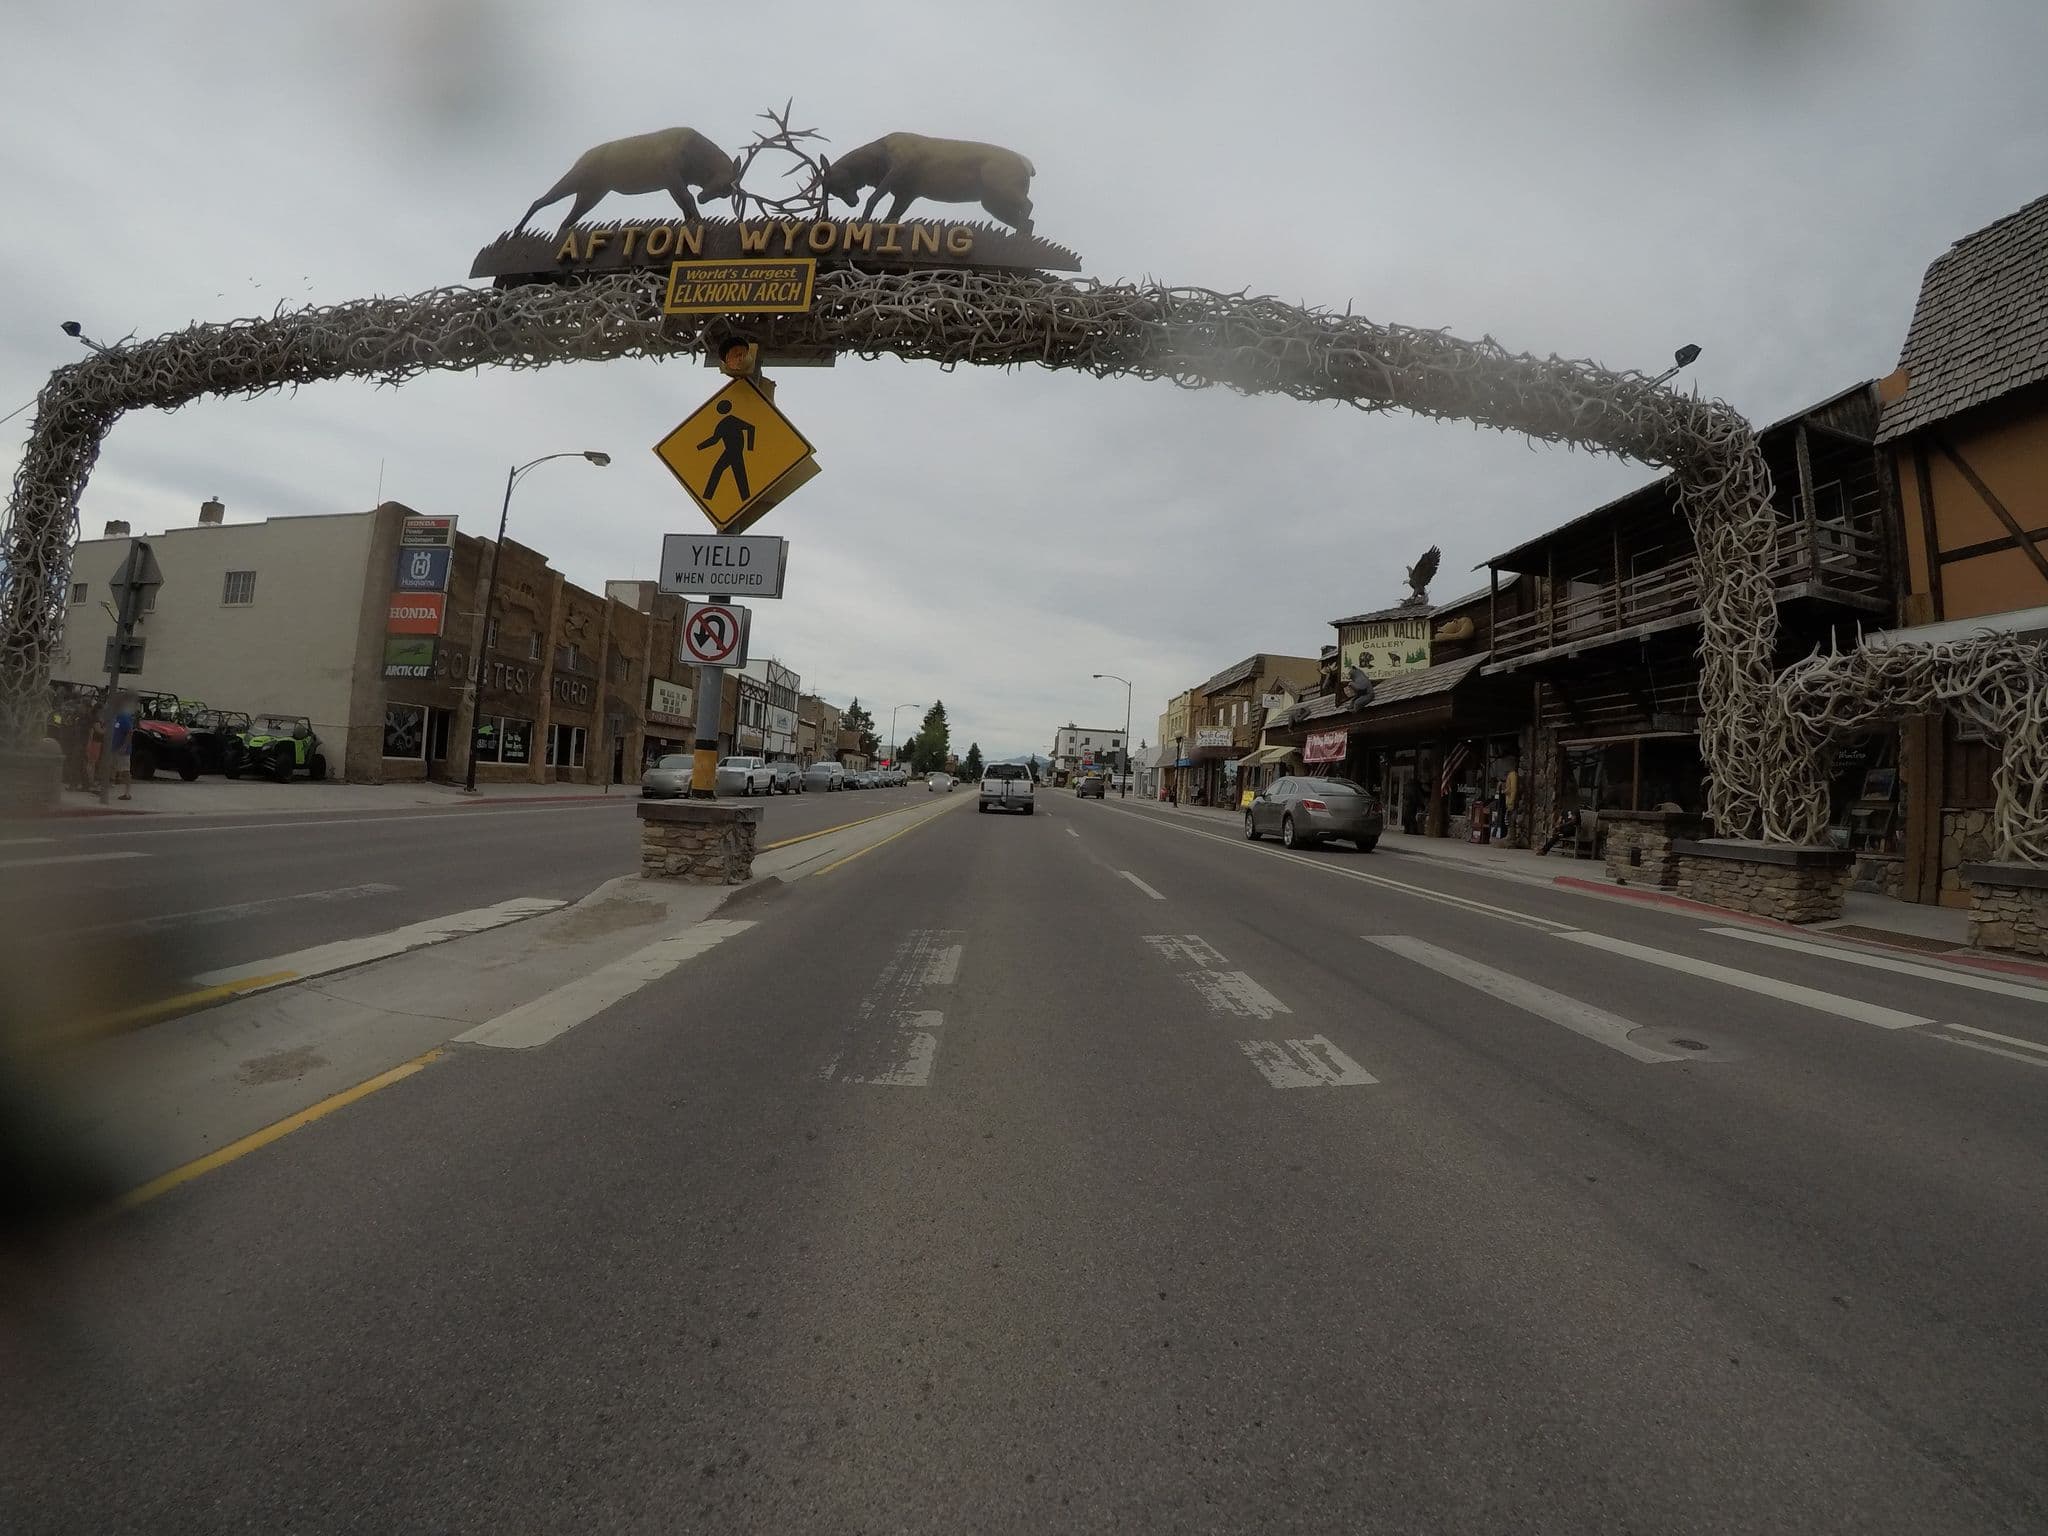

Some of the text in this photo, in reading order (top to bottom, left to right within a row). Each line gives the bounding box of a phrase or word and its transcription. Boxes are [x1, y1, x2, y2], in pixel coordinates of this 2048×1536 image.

[556, 220, 975, 263] AFTON WYOMING
[686, 267, 798, 281] World's Largest
[674, 282, 802, 303] ELKHORN ARCH
[692, 545, 751, 567] YIELD
[401, 579, 435, 588] Husqvarna
[675, 572, 763, 585] WHEN OCCUPIED
[389, 607, 437, 619] HONDA
[1342, 621, 1426, 646] MOUNTAIN VALLEY
[1362, 640, 1405, 649] GALLERY
[385, 666, 430, 677] ARCTIC CAT
[552, 677, 588, 705] FORD
